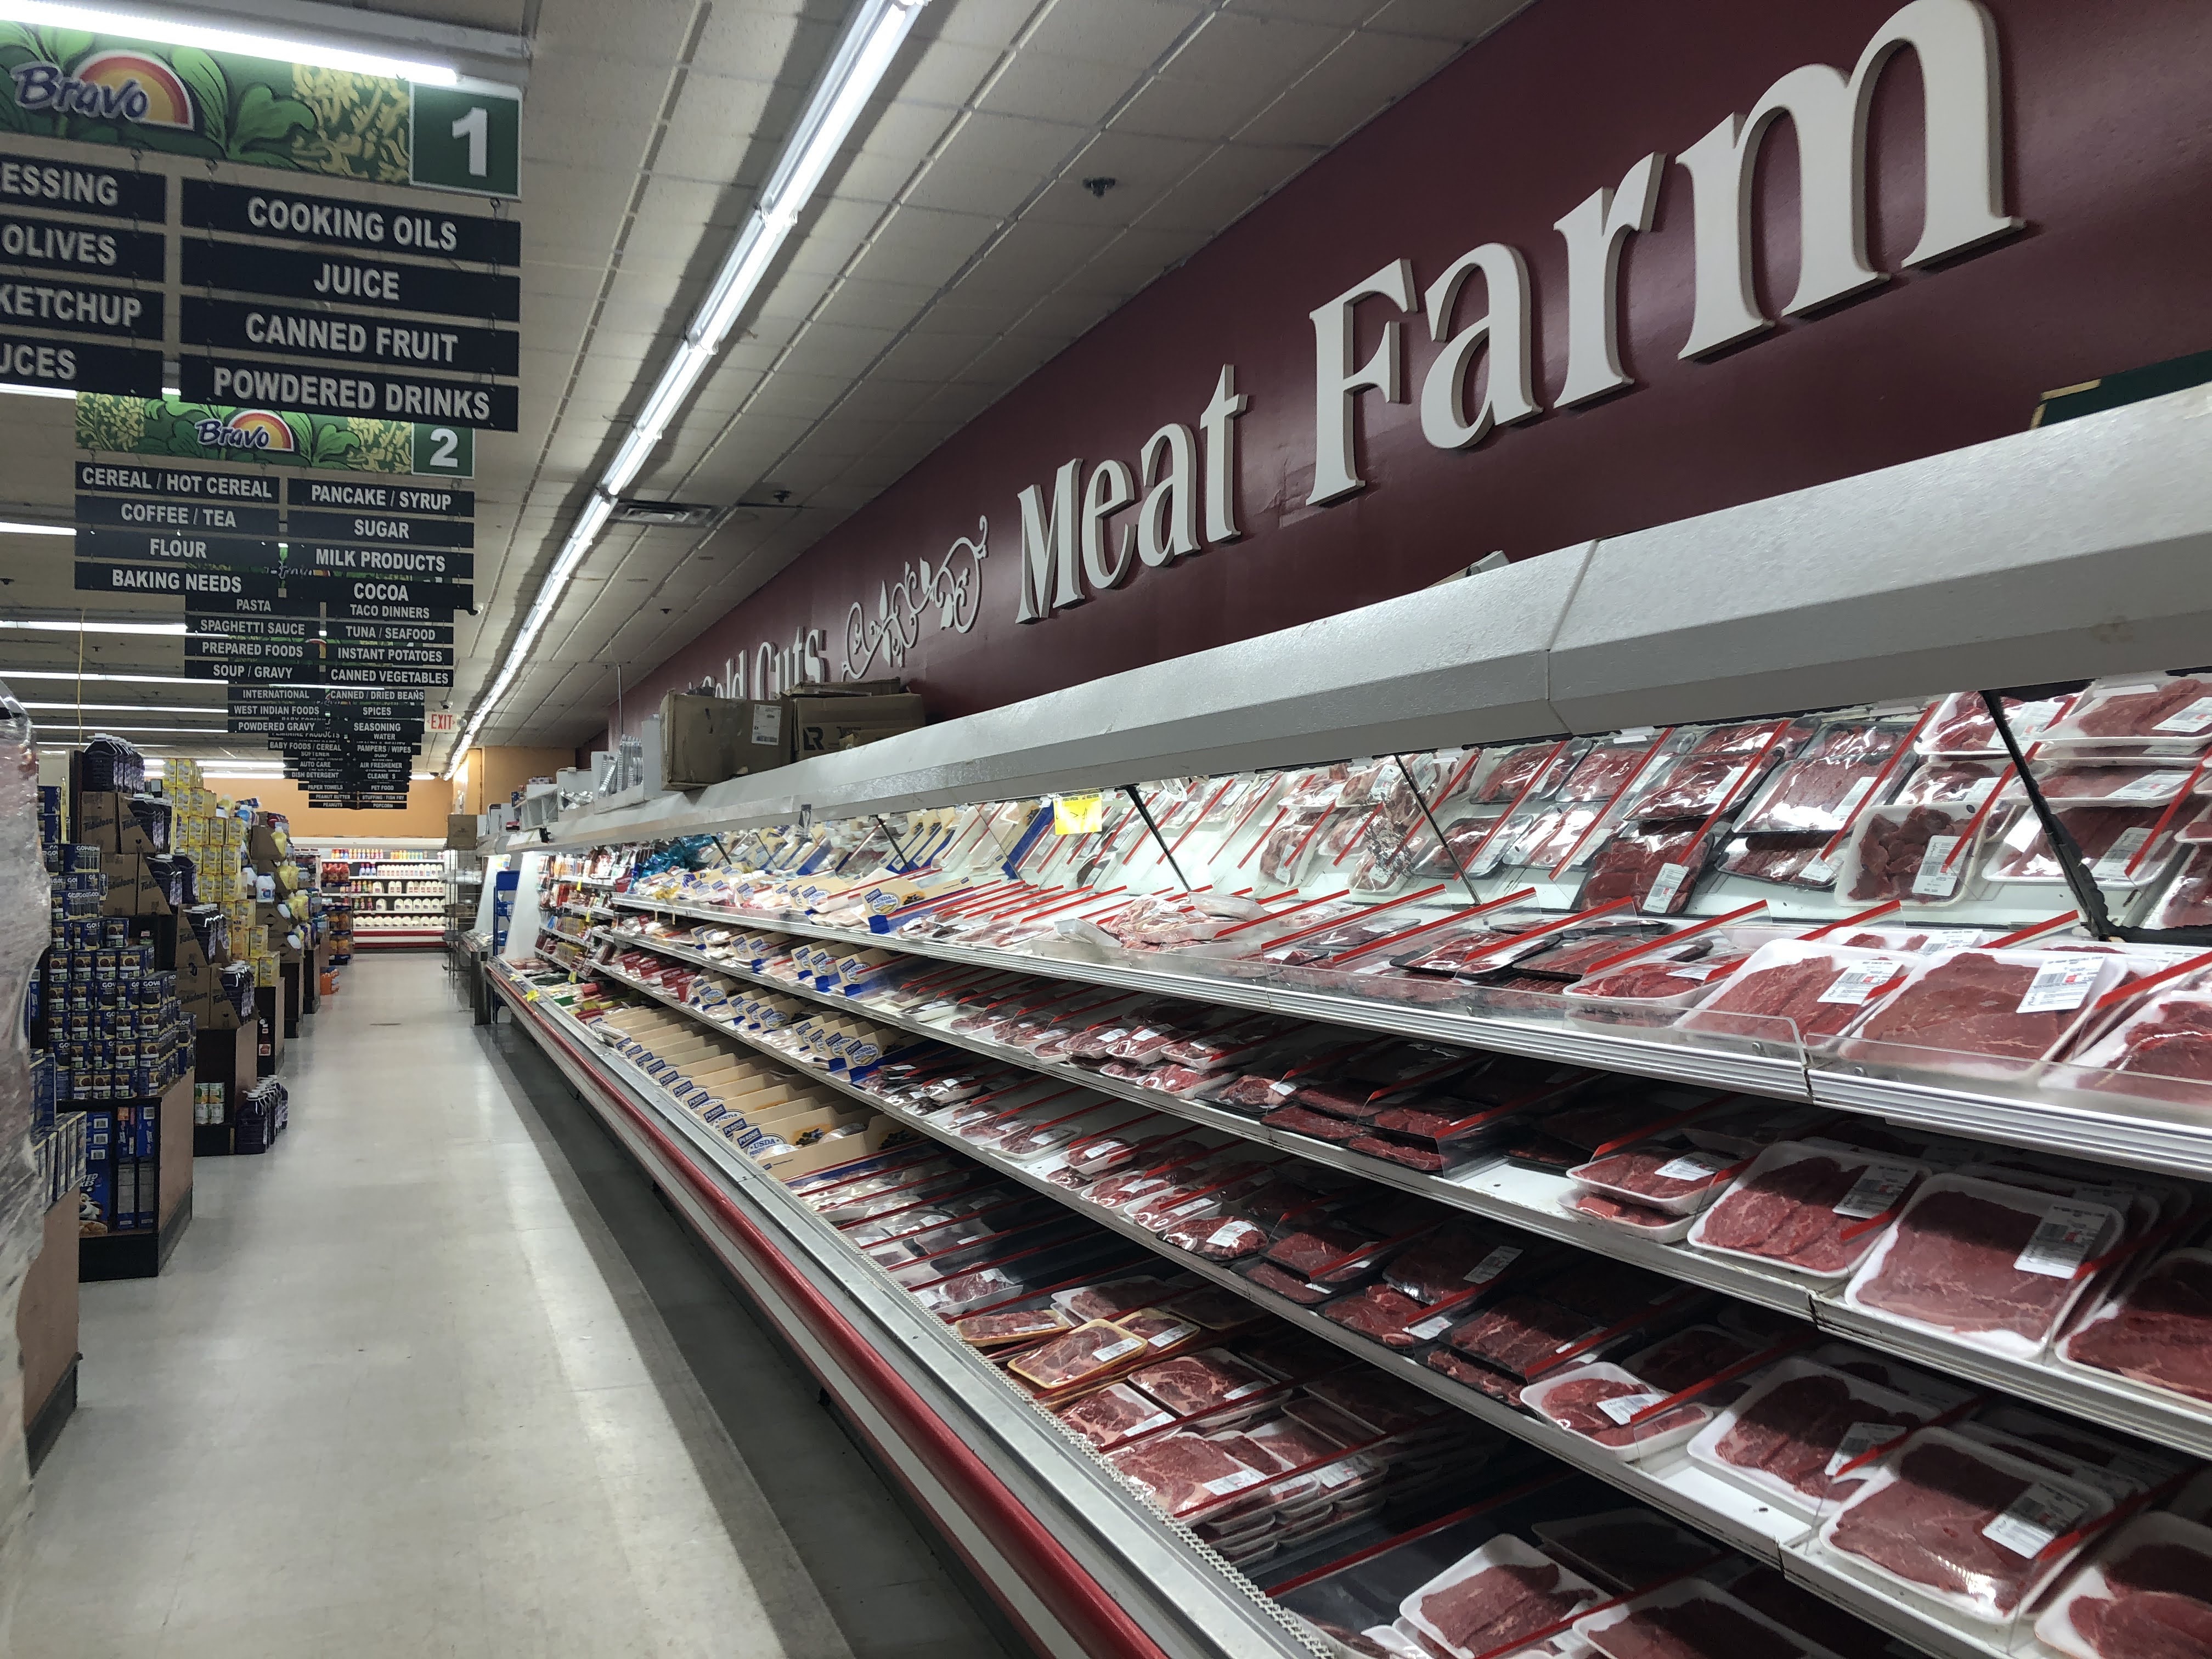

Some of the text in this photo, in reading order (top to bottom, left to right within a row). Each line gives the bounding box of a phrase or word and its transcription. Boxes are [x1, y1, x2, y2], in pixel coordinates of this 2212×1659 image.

[11, 61, 149, 123] Bravo
[452, 107, 489, 177] 1
[1, 162, 119, 207] ESSING
[248, 197, 458, 252] COOKING OILS
[2, 224, 116, 267] OLIVES
[1306, 0, 2025, 506] Farm
[314, 263, 400, 301] JUICE
[246, 313, 459, 363] CANNED FRUIT
[213, 366, 490, 420] POWDERED DRINKS
[194, 419, 270, 449] Bravo
[430, 428, 459, 467] 2
[82, 467, 152, 489] CEREAL
[167, 476, 202, 494] HOT
[206, 478, 272, 498] CEREAL
[312, 485, 386, 506] PANCAKE
[399, 492, 451, 511] SYRUP
[1015, 364, 1248, 623] Meat
[121, 504, 189, 524] COFFEE
[203, 509, 236, 528] TEA
[354, 520, 409, 539] SUGAR
[150, 539, 206, 558] FLOUR
[316, 549, 445, 573] MILK PRODUCTS
[112, 569, 242, 593] BAKING NEEDS
[354, 583, 408, 602] COCOA
[236, 599, 271, 611] PASTA
[350, 604, 430, 619] TACO DINNERS
[201, 619, 304, 635] SPAGHETTI SAUCE
[346, 626, 376, 637] TUNA
[385, 628, 435, 640] SEAFOOD
[202, 642, 303, 657] PREPARED FOODS
[338, 647, 442, 662] INSTANT POTATOES
[213, 664, 245, 676] SOUP
[255, 667, 292, 679] GRAVY
[331, 669, 448, 684] CANNED VEGETABLES
[243, 690, 309, 698] INTERNATIONAL
[331, 691, 364, 699] CANNED
[398, 691, 424, 701] BEANS
[234, 706, 257, 714] WEST
[261, 706, 289, 714] INDIAN
[363, 707, 391, 715] SPICES
[239, 722, 315, 731] POWDERED GRAVY
[354, 723, 400, 731] SEASONING
[431, 714, 453, 729] EXIT
[724, 1120, 744, 1133] PERDUE
[739, 1131, 759, 1144] PERDUE
[754, 1139, 776, 1148] USDA
